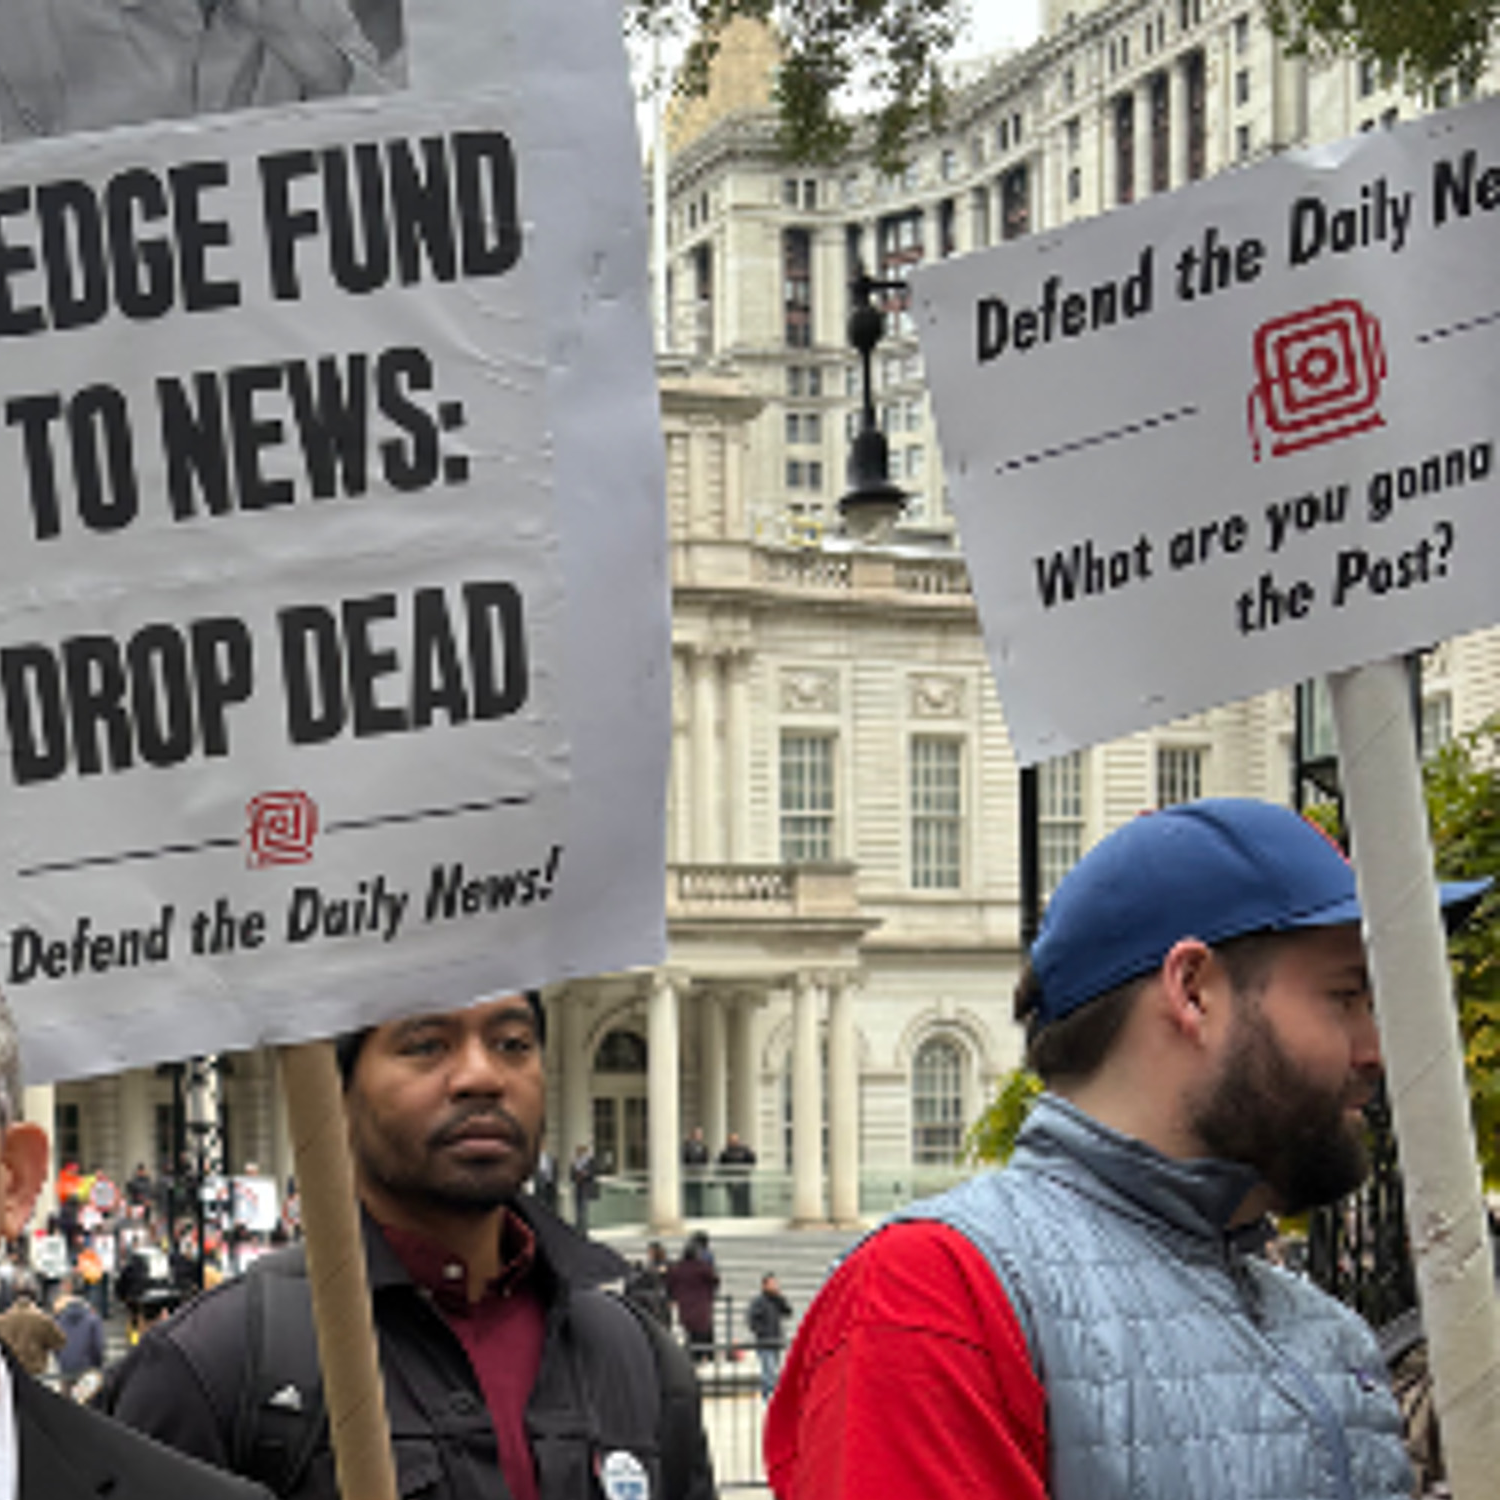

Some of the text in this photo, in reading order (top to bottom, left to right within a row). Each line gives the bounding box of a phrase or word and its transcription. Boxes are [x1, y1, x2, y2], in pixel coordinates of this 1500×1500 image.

[258, 131, 523, 301] FUND
[977, 246, 1154, 364] Defend
[1176, 228, 1265, 302] the
[1289, 178, 1412, 267] Daily
[5, 347, 470, 541] TO NEWS:
[1036, 442, 1493, 608] What are you gonna
[1236, 521, 1455, 636] the Post?
[0, 581, 529, 786] DROP DEAD
[8, 845, 564, 985] Defend the Daily News!
